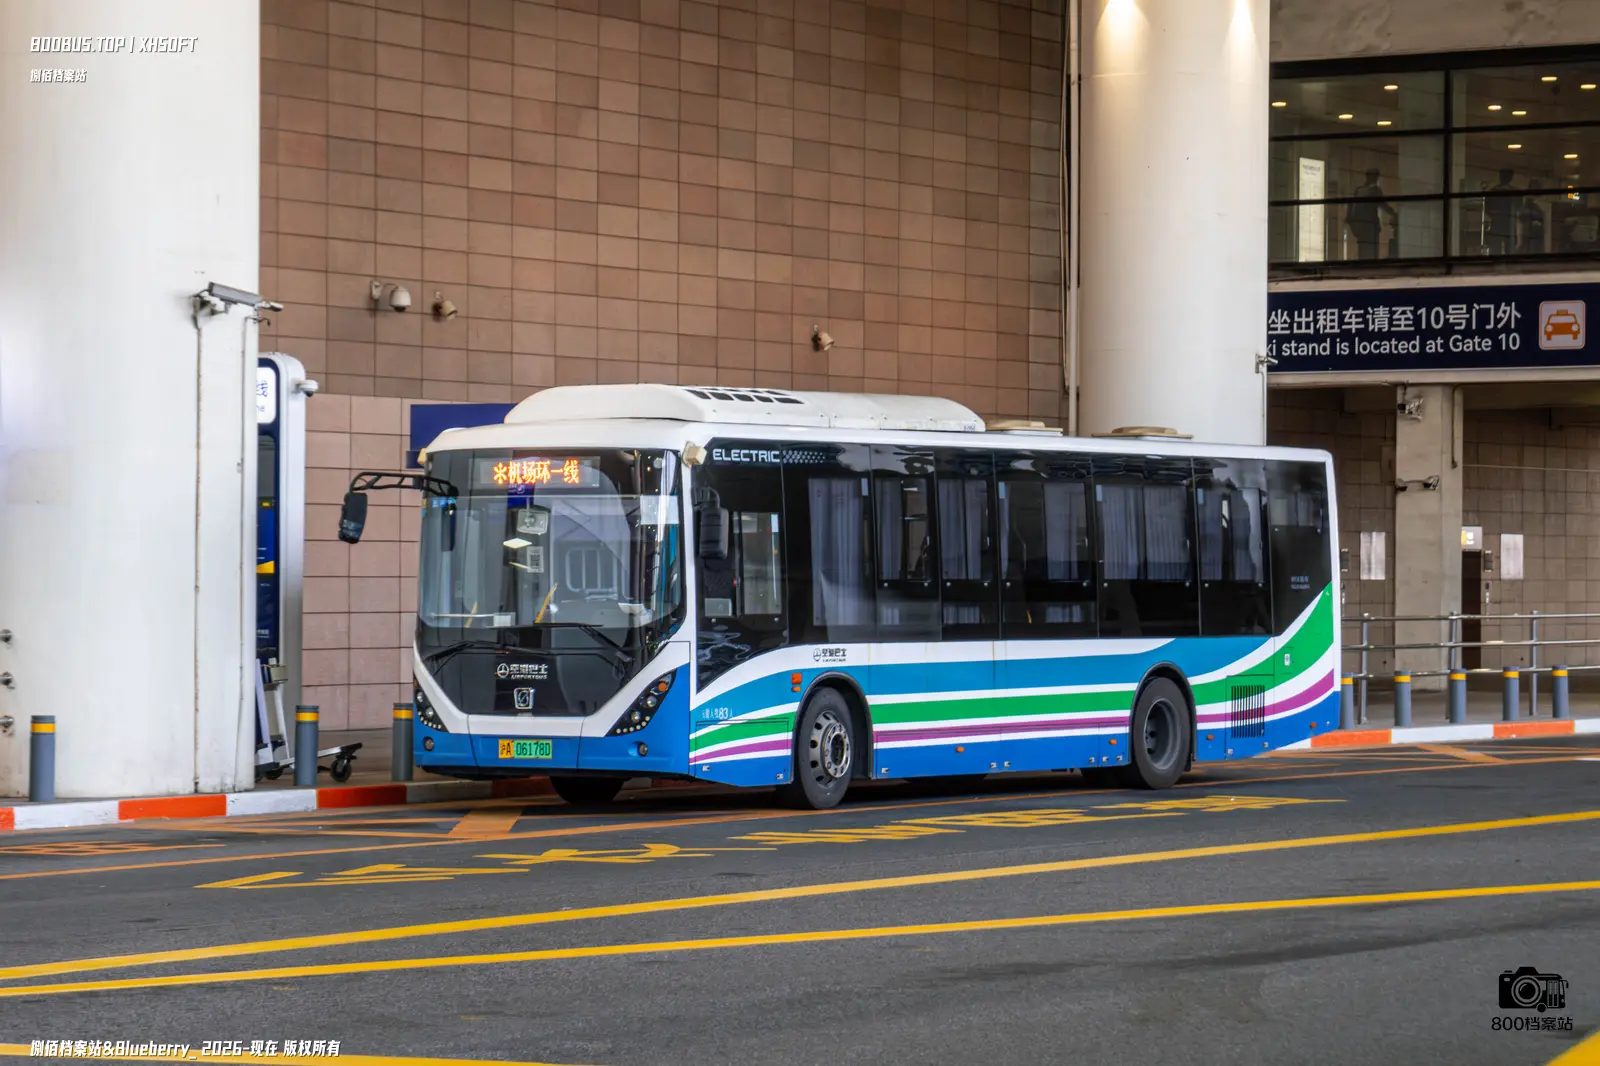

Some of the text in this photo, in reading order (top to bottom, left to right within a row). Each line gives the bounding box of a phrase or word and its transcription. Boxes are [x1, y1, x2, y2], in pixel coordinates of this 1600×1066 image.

[1268, 301, 1522, 335] 坐出租车请至10号门外
[1281, 337, 1331, 356] stand
[1336, 338, 1350, 355] is
[1354, 335, 1421, 355] located
[1425, 336, 1445, 354] at
[1449, 334, 1493, 353] Gate
[1498, 332, 1521, 351] 10
[712, 448, 781, 463] ELECTRIC
